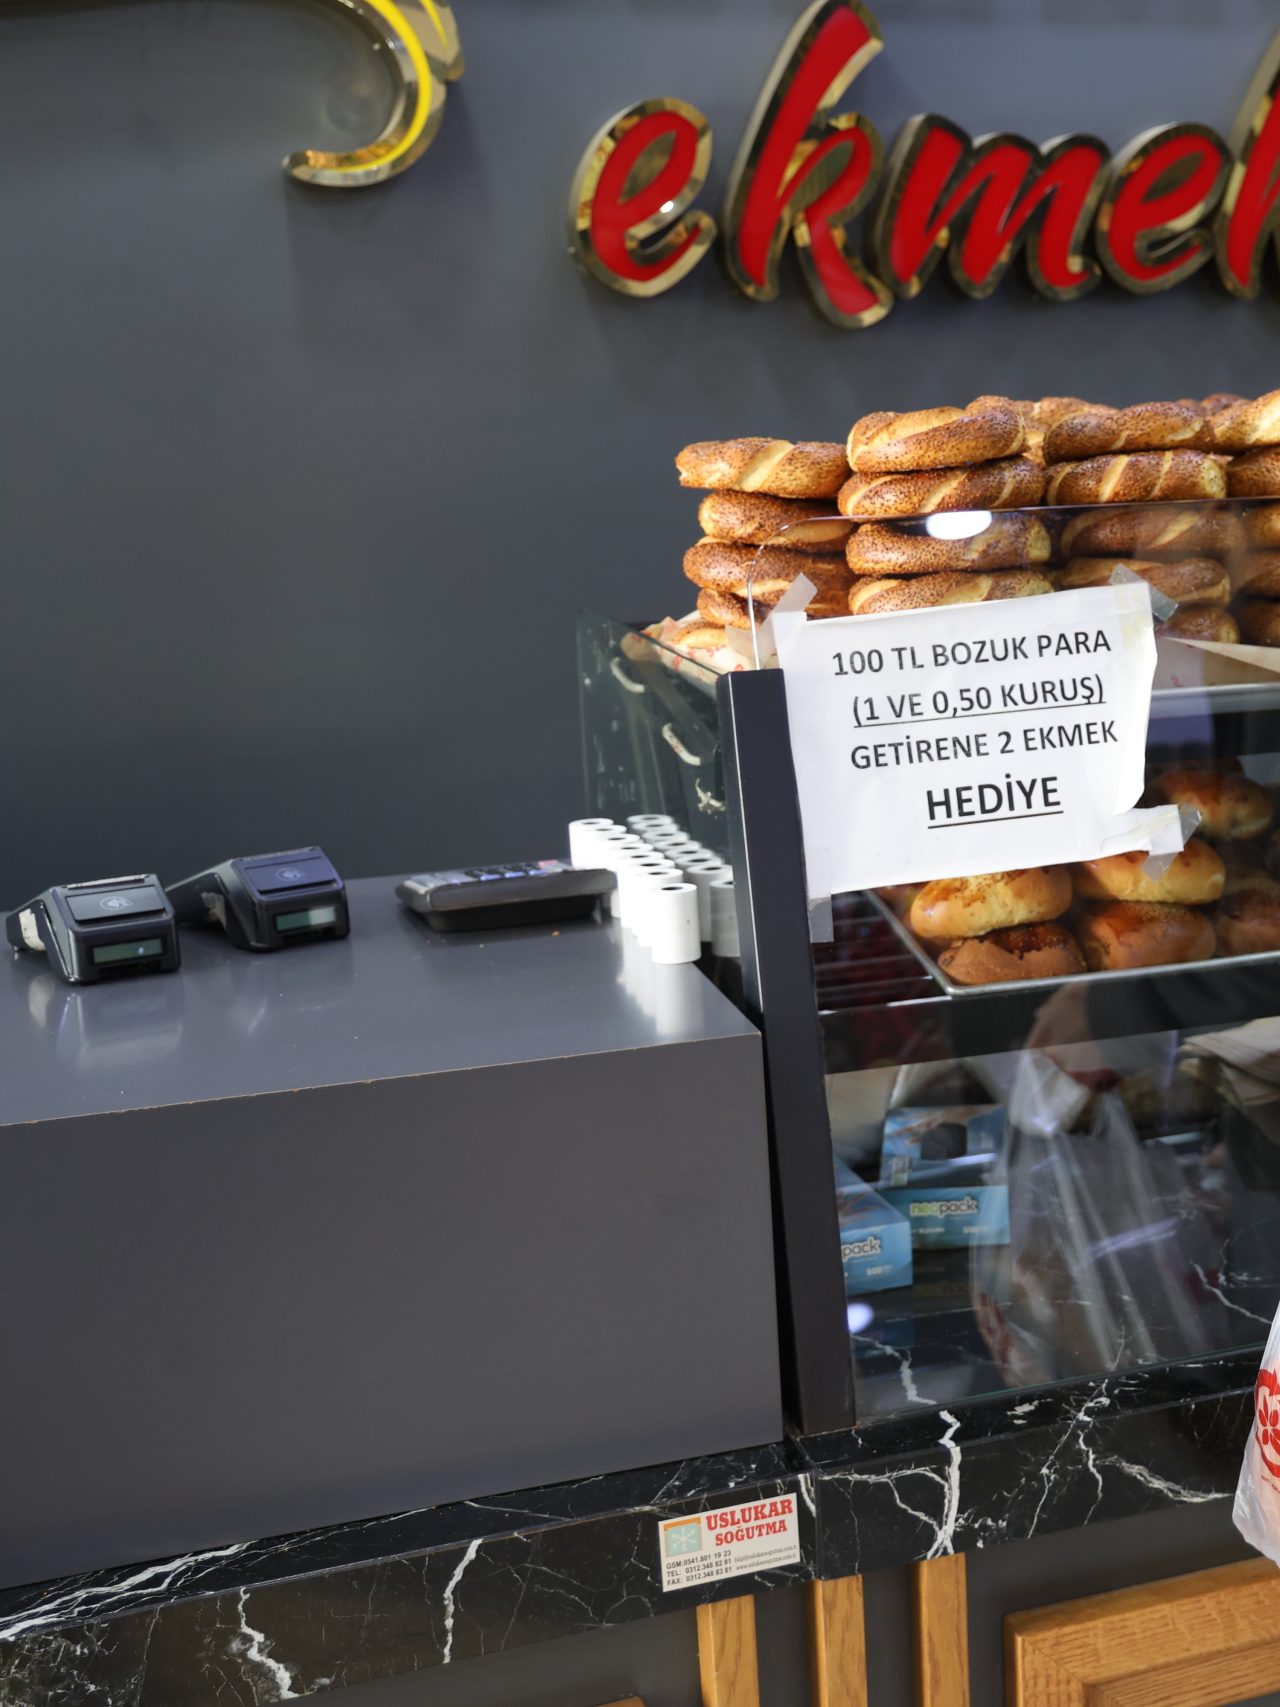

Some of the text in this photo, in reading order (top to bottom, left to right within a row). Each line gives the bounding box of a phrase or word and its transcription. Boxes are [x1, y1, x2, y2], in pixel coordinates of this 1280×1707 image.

[832, 630, 1111, 675] 100 TL BOZUK PARA
[853, 674, 1104, 727] (1 VE 0,50 KURUŞ)
[850, 720, 1118, 769] GETİRENE 2 EKMEK
[927, 773, 1061, 821] HEDİYE
[909, 1196, 978, 1218] neopack
[706, 1499, 793, 1531] USLUKAR
[715, 1519, 787, 1546] SOĞUTMA
[667, 1577, 683, 1586] FAX:
